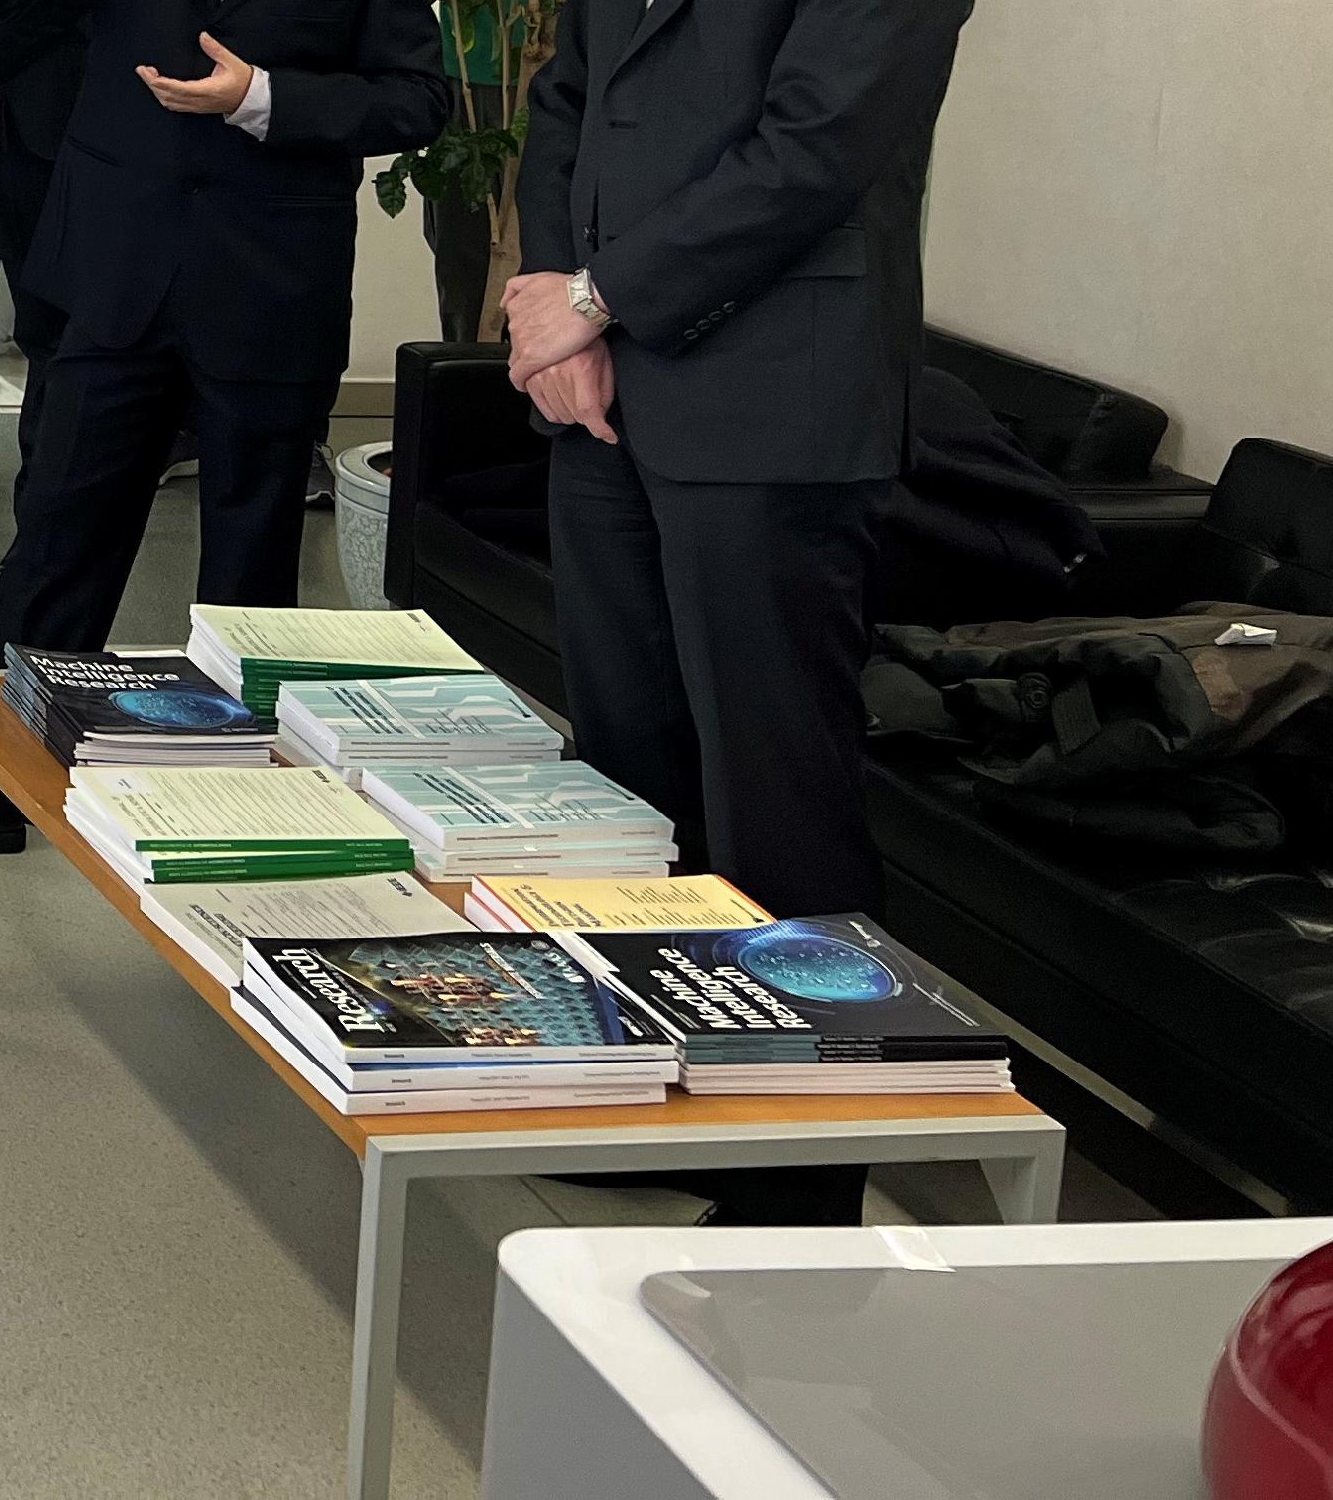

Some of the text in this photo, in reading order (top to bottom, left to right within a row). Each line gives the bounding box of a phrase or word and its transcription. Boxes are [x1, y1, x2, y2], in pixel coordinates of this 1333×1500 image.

[30, 656, 134, 673] Machine
[37, 665, 181, 681] Intelligence
[46, 674, 157, 690] Research
[272, 948, 386, 1034] Research
[649, 969, 742, 1029] Machine
[658, 948, 776, 1029] Intelligence
[713, 966, 813, 1029] Research
